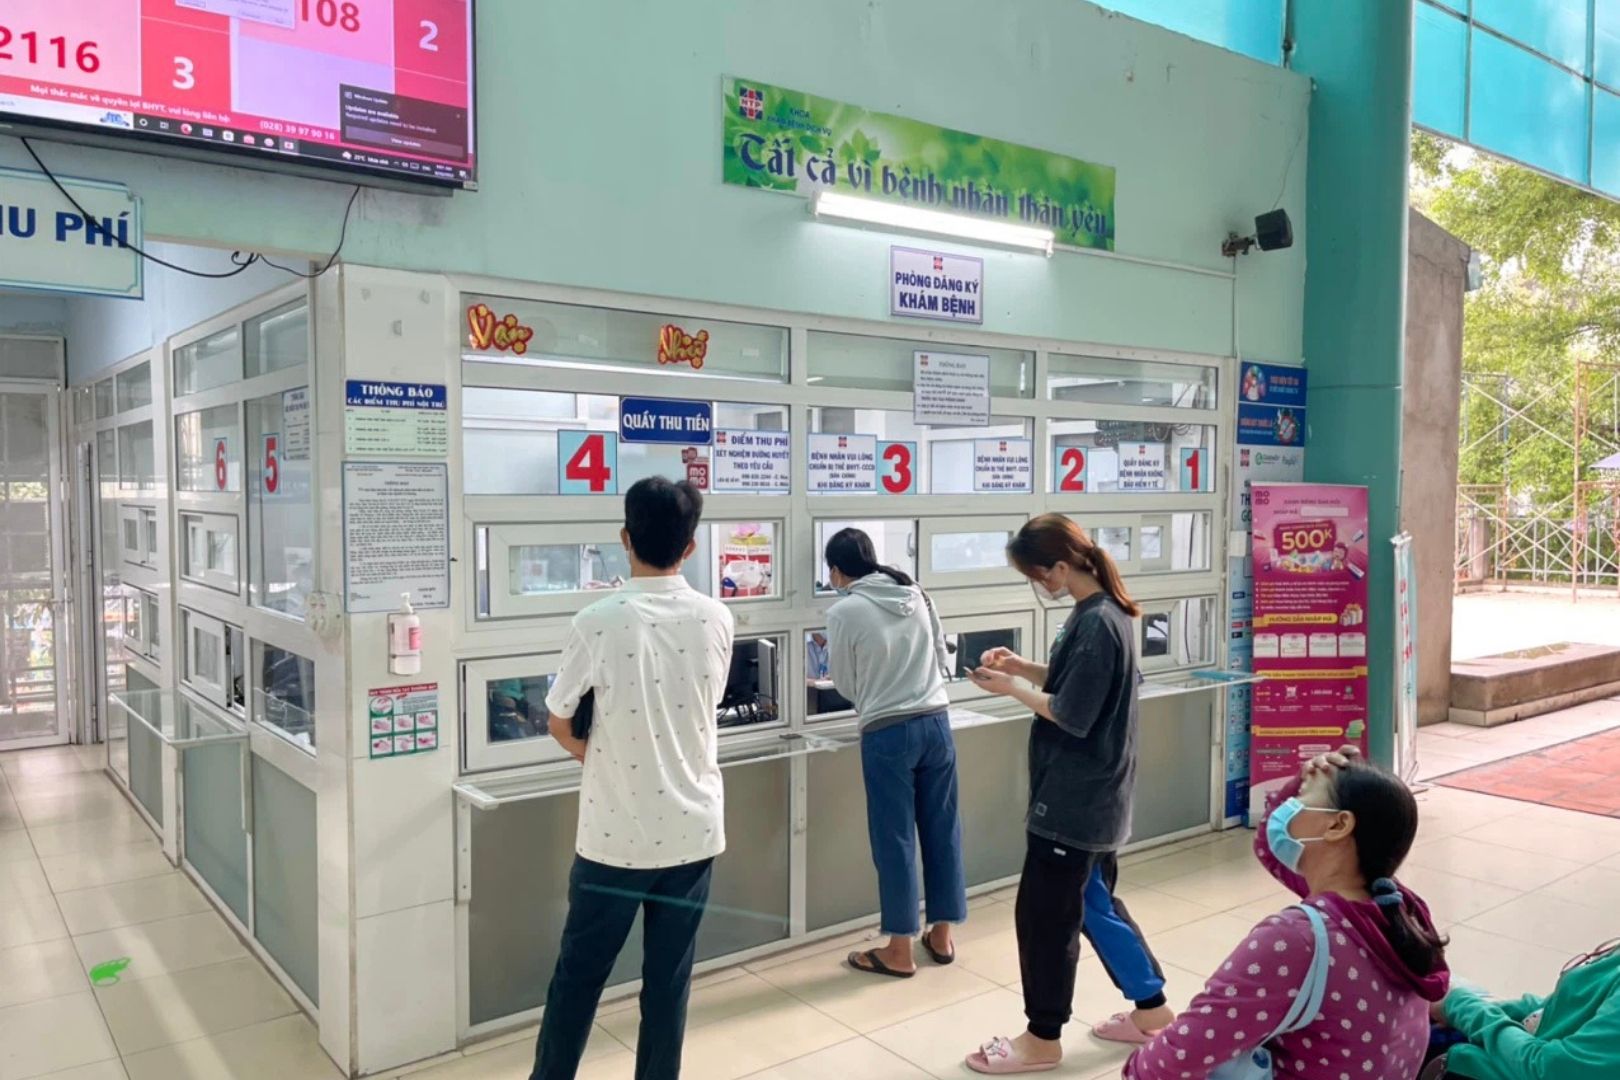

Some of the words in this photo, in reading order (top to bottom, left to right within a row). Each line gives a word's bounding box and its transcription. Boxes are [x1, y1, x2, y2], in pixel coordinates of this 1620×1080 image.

[0, 26, 100, 73] 2116
[419, 20, 439, 52] 2
[172, 57, 195, 89] 3
[739, 133, 796, 177] Tất
[806, 147, 837, 186] cả
[847, 157, 872, 193] vì
[882, 164, 943, 206] bệnh
[952, 180, 1010, 217] nhân
[1018, 192, 1065, 227] thân
[1071, 204, 1107, 237] yêu
[0, 204, 35, 238] U
[56, 211, 130, 248] PHÍ
[895, 270, 931, 289] PHÒNG
[933, 274, 962, 291] ĐĂNG
[964, 278, 979, 294] KÝ
[899, 289, 939, 311] KHÁM
[942, 294, 976, 318] BỆNH
[347, 395, 362, 405] CÁC
[364, 395, 383, 406] ĐIỂM
[361, 382, 404, 397] THÔNG
[407, 384, 433, 398] BÁO
[658, 415, 683, 430] THU
[731, 432, 753, 445] ĐIỂM
[755, 436, 772, 446] THU
[774, 435, 788, 447] PHÍ
[215, 440, 227, 491] 6
[265, 436, 278, 494] 5
[566, 434, 611, 492] 4
[733, 462, 748, 470] THEO
[750, 460, 761, 470] YÊU
[762, 459, 773, 470] CẦU
[809, 461, 826, 470] CHUẨN
[811, 451, 828, 461] BỆNH
[829, 451, 845, 460] NHÂN
[858, 452, 873, 461] LÒNG
[881, 443, 912, 494] 3
[1060, 448, 1085, 492] 2
[1186, 449, 1200, 490] 1
[829, 480, 844, 488] ĐĂNG
[1282, 528, 1333, 550] 500K
